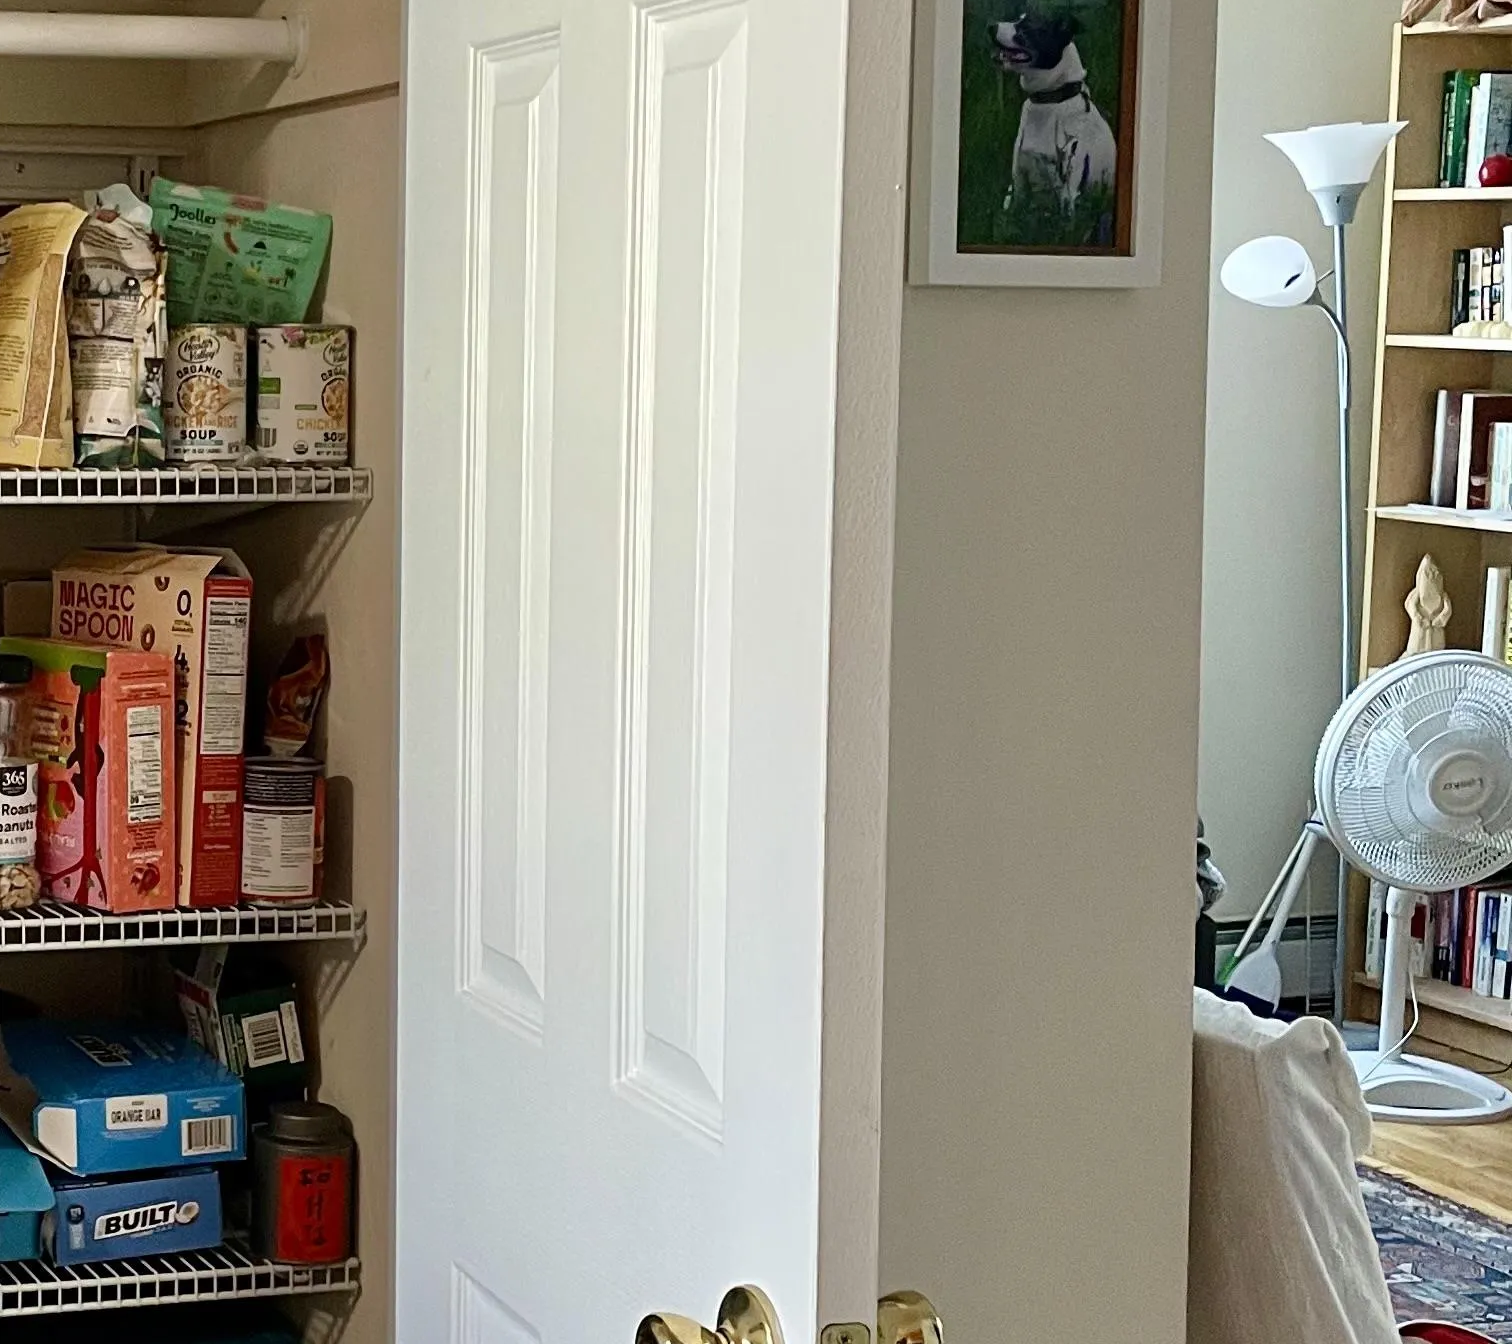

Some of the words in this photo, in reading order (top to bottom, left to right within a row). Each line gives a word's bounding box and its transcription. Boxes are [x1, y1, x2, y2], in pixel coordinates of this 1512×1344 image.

[176, 365, 223, 380] ORGANIC
[179, 429, 217, 440] SOUP
[59, 580, 135, 612] MAGIC
[59, 608, 134, 642] SPOON
[1, 770, 25, 787] 365
[110, 1109, 144, 1124] ORANGE
[145, 1108, 162, 1122] BAR
[104, 1205, 176, 1235] BUILT
